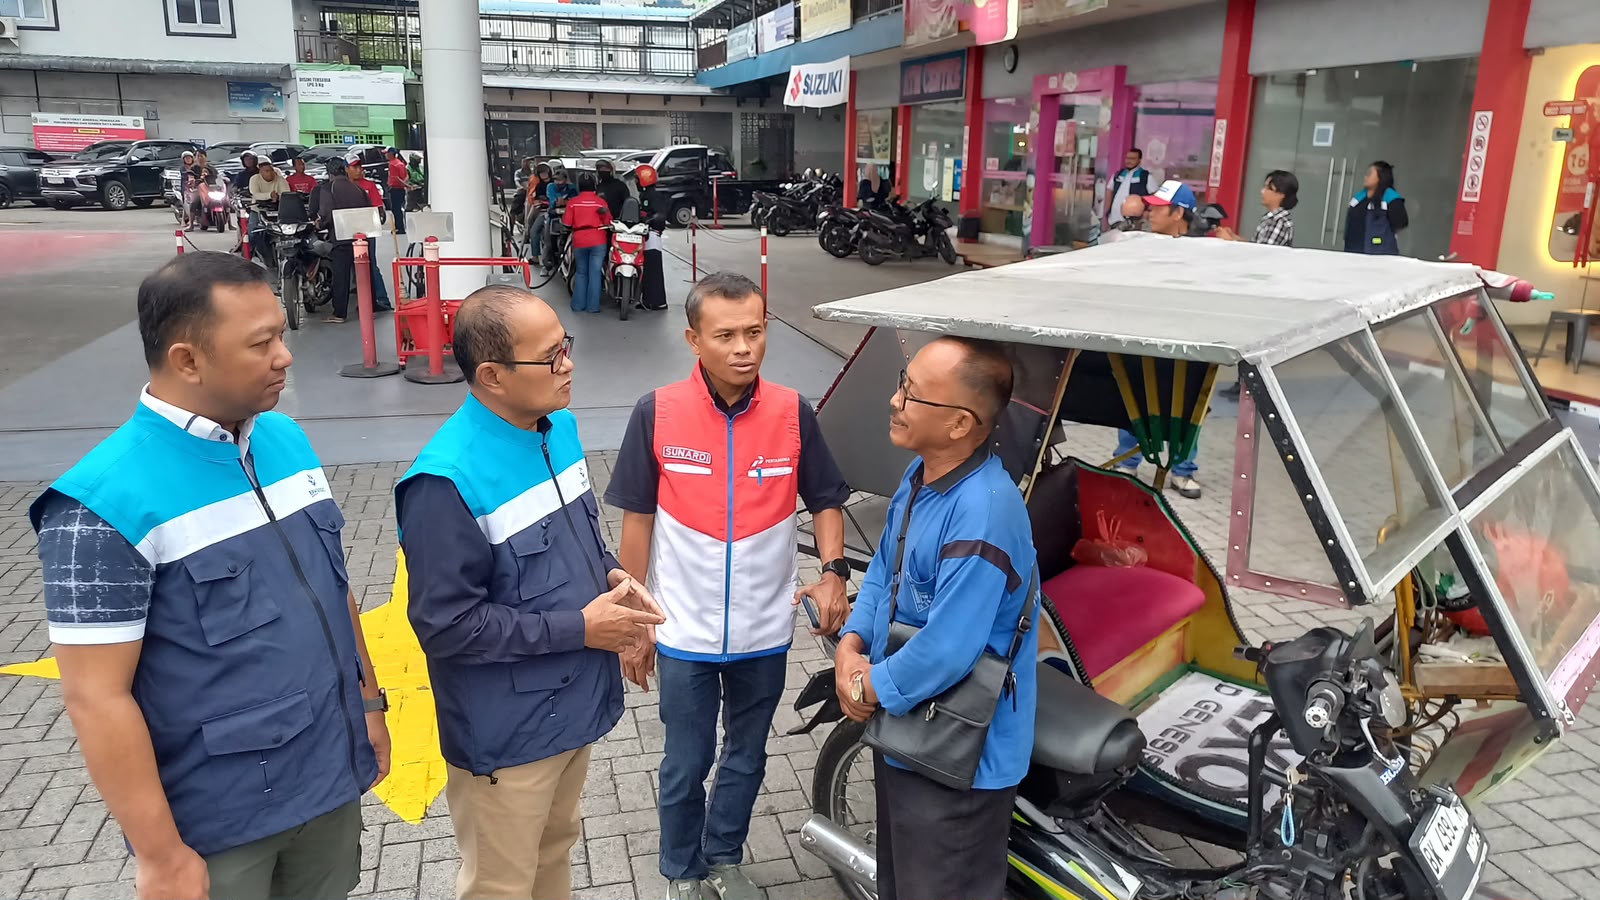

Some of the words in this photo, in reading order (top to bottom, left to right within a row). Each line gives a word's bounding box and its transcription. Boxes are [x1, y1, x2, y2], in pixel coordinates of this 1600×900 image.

[803, 69, 842, 95] SUZUKI
[665, 447, 710, 463] SUNARDI
[1423, 841, 1444, 874] BK
[1435, 810, 1458, 851] 4994
